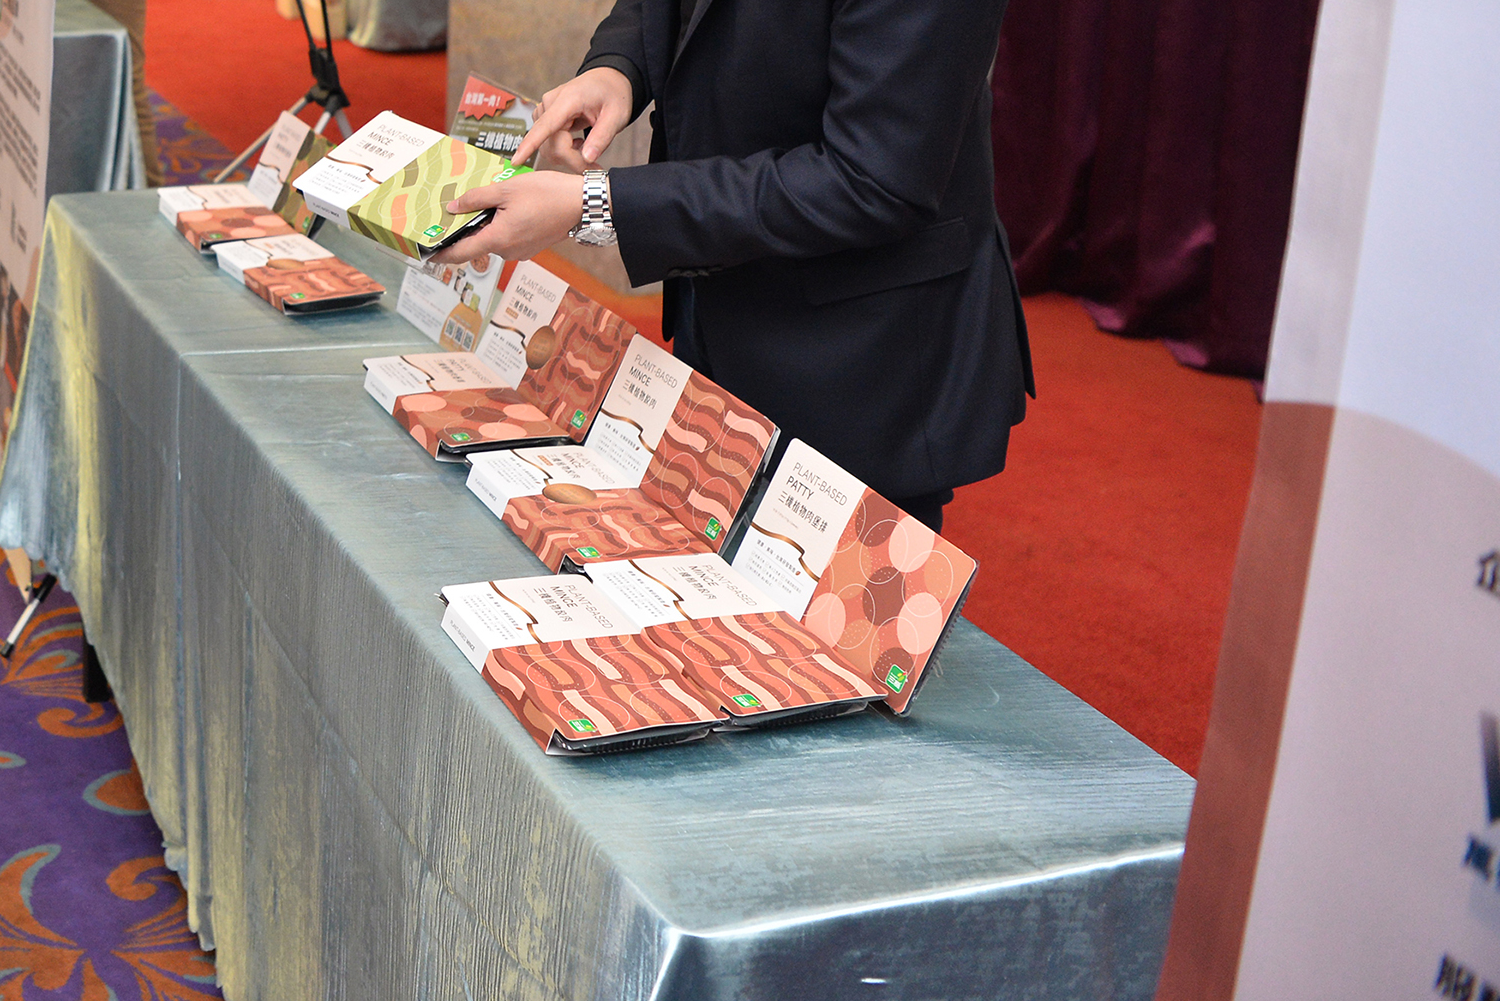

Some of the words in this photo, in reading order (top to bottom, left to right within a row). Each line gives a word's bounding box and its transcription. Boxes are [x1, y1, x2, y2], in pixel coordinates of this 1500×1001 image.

[368, 131, 394, 147] MINCE
[377, 123, 426, 148] PLANT-BASED
[515, 285, 535, 303] MINCE
[520, 274, 557, 303] PLANT-BASED
[628, 366, 652, 387] MINCE
[634, 354, 678, 389] PLANT-BASED
[561, 452, 586, 469] MINCE
[786, 475, 814, 500] PATTY
[792, 462, 848, 507] PLANT-BASED
[688, 564, 720, 587] MINCE
[702, 564, 757, 607] PLANT-BASED
[550, 585, 579, 610] MINCE
[564, 583, 614, 630] PLANT-BASED
